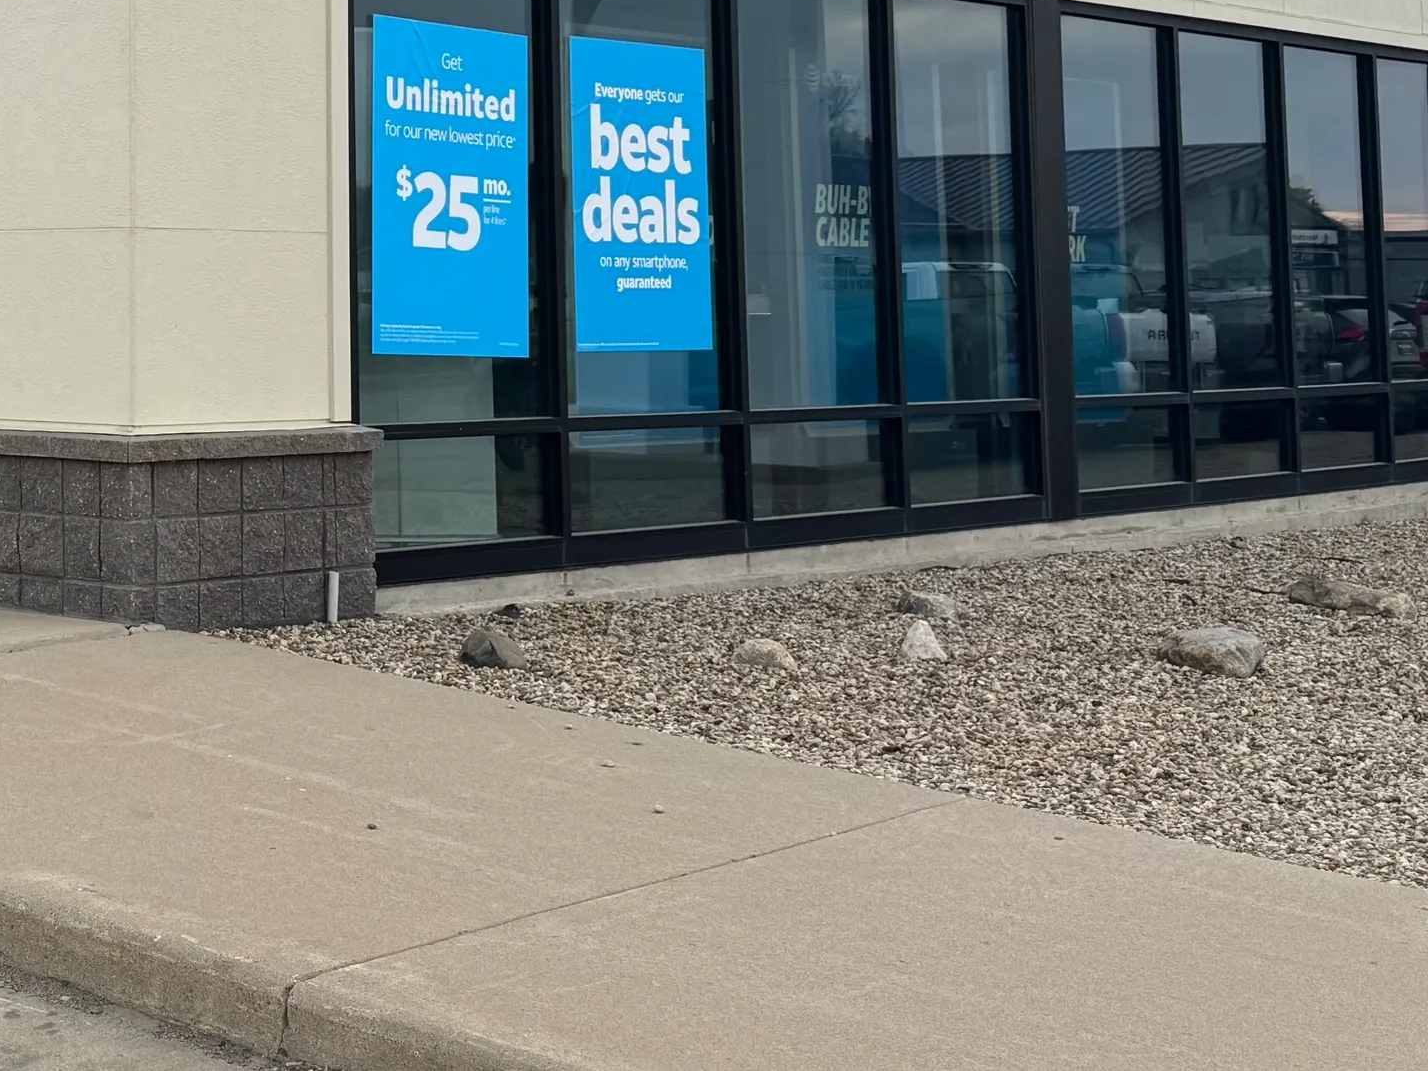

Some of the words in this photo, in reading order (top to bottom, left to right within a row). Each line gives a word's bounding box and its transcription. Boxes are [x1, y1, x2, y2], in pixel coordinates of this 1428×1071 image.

[441, 52, 463, 71] Get
[386, 75, 516, 122] Unlimited
[594, 82, 643, 103] Everyone
[644, 88, 666, 104] gets
[668, 90, 684, 104] our
[385, 119, 401, 136] for
[403, 125, 422, 139] our
[424, 127, 447, 141] new
[448, 126, 484, 146] lowest
[590, 103, 692, 175] best
[396, 164, 481, 251] $25
[483, 178, 511, 197] mo.
[582, 175, 700, 245] deals
[816, 216, 870, 247] CABLE
[600, 255, 612, 267] on
[614, 255, 631, 270] any
[632, 254, 688, 272] smartphone,
[616, 275, 672, 293] guaranteed
